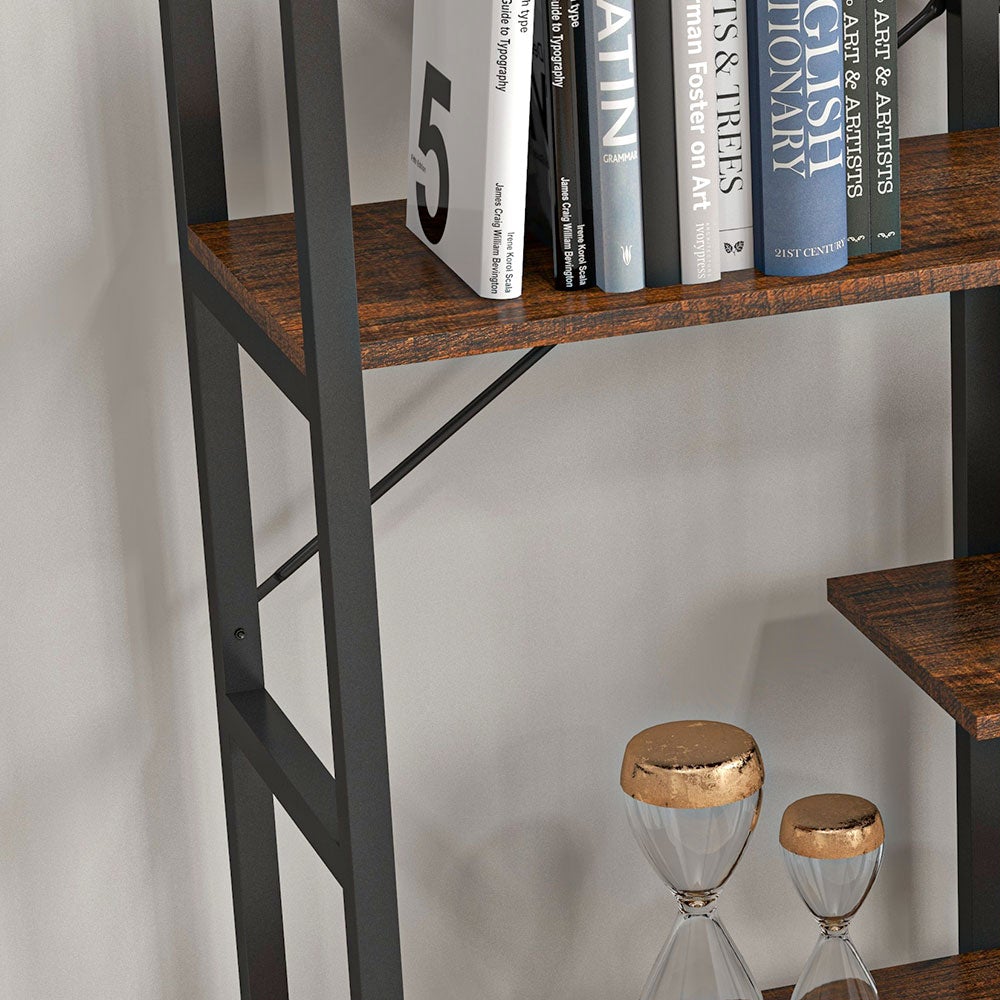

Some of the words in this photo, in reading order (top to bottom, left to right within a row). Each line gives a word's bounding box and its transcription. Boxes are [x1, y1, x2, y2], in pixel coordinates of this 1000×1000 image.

[518, 10, 530, 33] type
[551, 22, 563, 32] to
[568, 4, 580, 28] type
[500, 27, 511, 36] to
[843, 12, 860, 63] ART
[874, 8, 891, 60] ART
[495, 39, 511, 92] Typography
[550, 34, 565, 88] Typography
[597, 0, 638, 147] ATIN
[714, 51, 739, 78] &
[803, 0, 843, 177] GLISH
[844, 69, 861, 90] &
[875, 66, 892, 87] &
[688, 61, 708, 135] Foster
[715, 83, 744, 195] TREES
[845, 95, 863, 199] ARTISTS
[875, 91, 893, 195] ARTISTS
[416, 61, 451, 245] 5
[602, 150, 638, 163] GRAMMAR
[689, 140, 706, 169] on
[494, 182, 504, 207] James
[560, 176, 570, 201] James
[691, 175, 712, 211] Art
[492, 208, 503, 228] Craig
[561, 202, 571, 222] Craig
[492, 229, 503, 256] William
[506, 231, 515, 250] Irene
[563, 222, 573, 250] William
[577, 224, 585, 243] Irene
[578, 244, 587, 265] Korol
[693, 223, 706, 279] ivorypress
[774, 248, 802, 258] 21ST
[803, 237, 847, 258] CENTURY
[506, 251, 514, 272] Korol
[563, 250, 574, 288] Bevington
[489, 257, 501, 294] Bevington
[505, 273, 513, 293] Scala
[578, 265, 588, 286] Scala
